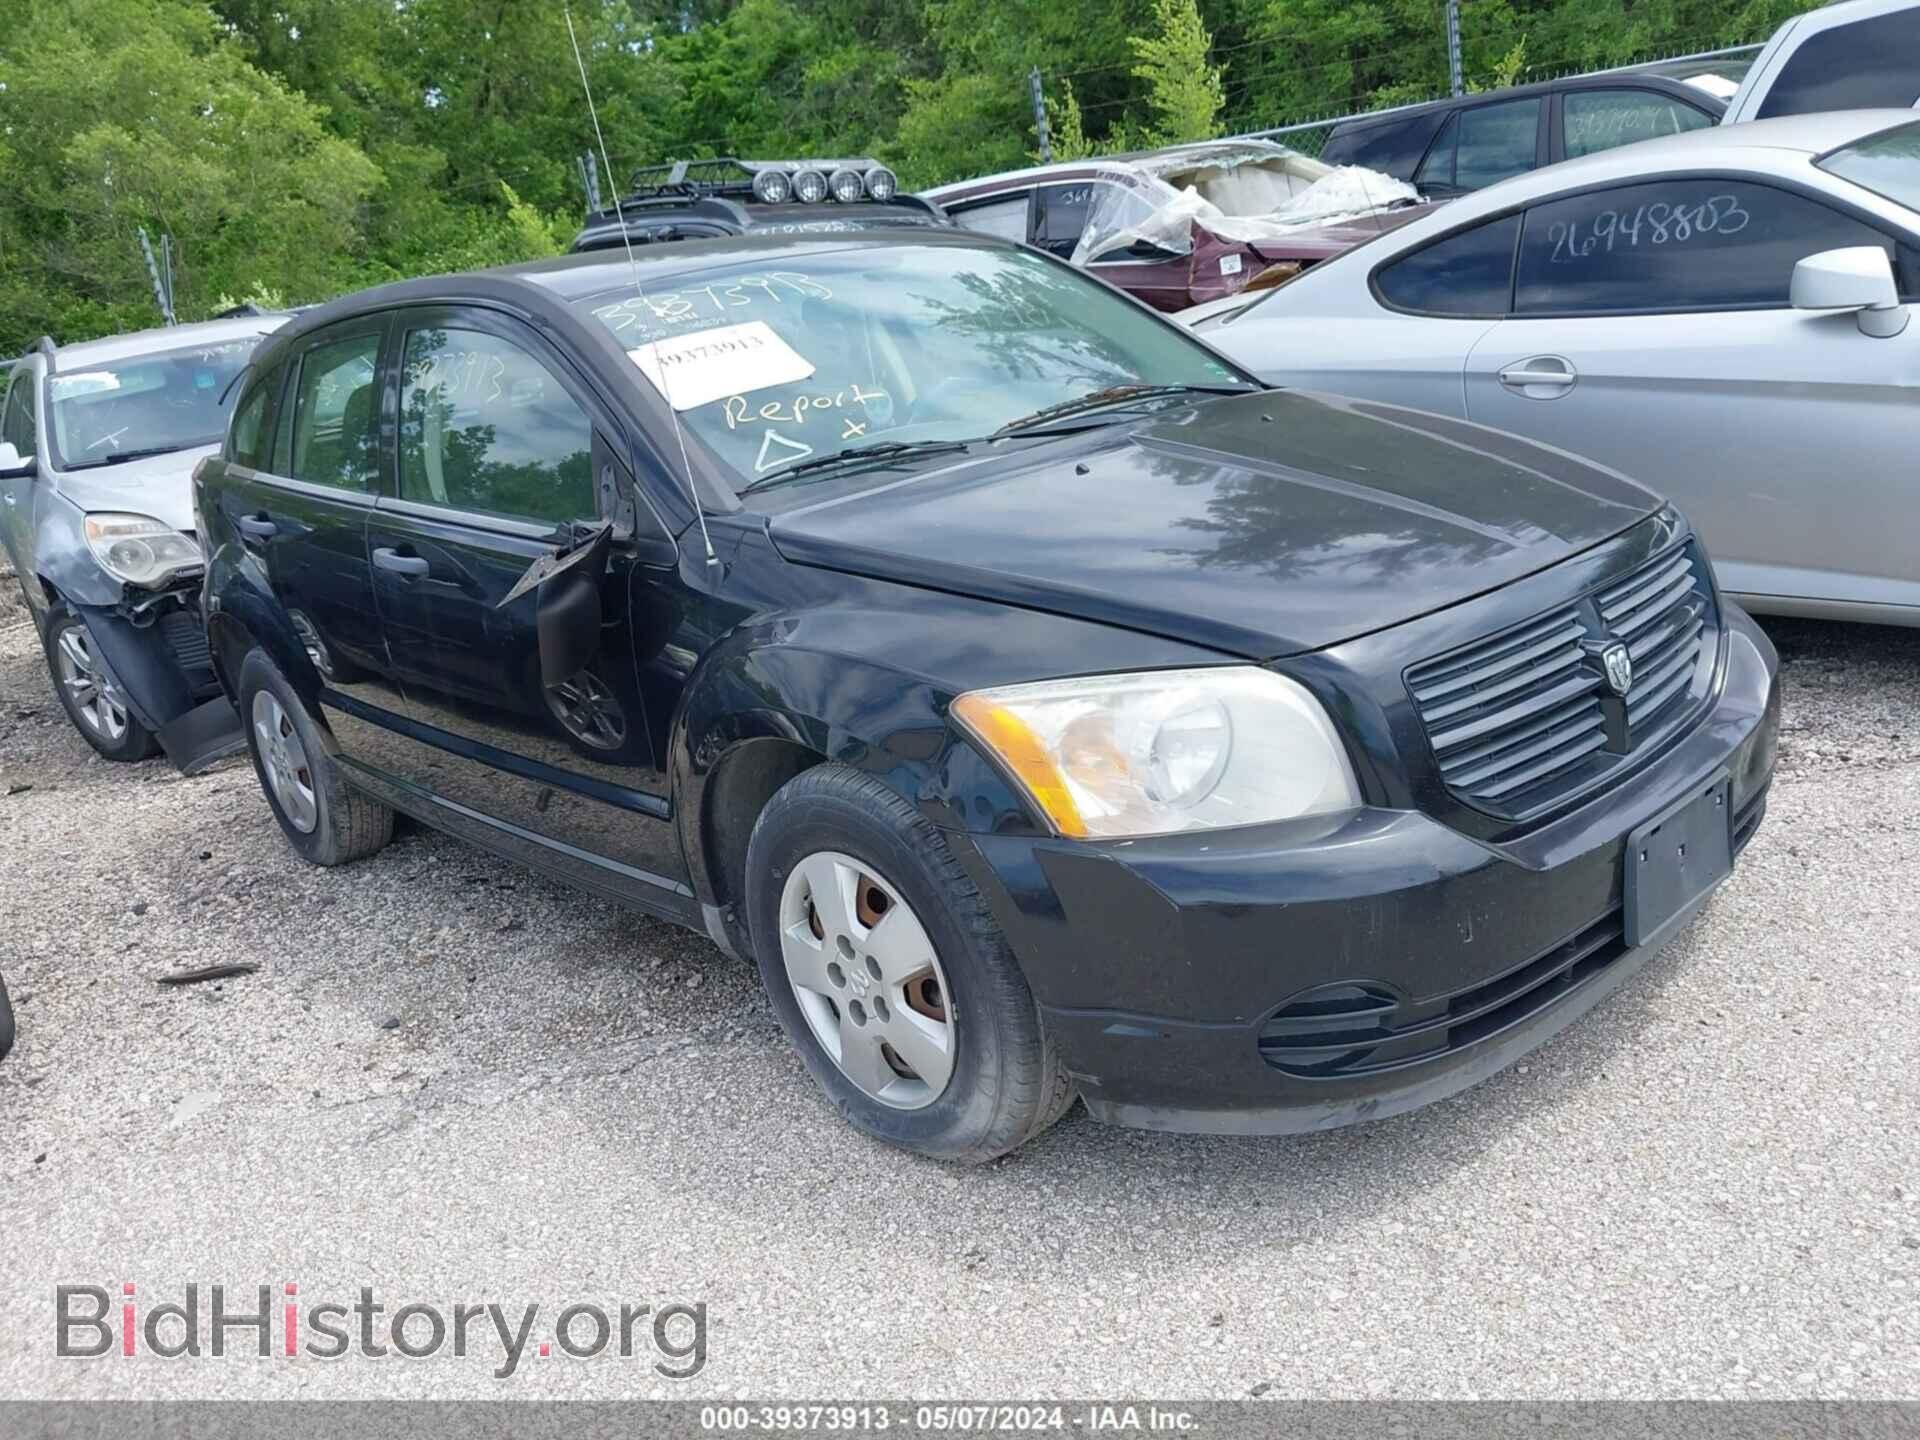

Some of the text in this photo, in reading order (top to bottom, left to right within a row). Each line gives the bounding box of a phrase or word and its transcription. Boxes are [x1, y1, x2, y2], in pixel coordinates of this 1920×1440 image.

[1548, 195, 1750, 263] 26948803
[656, 334, 766, 368] 39373913
[722, 384, 885, 430] Report
